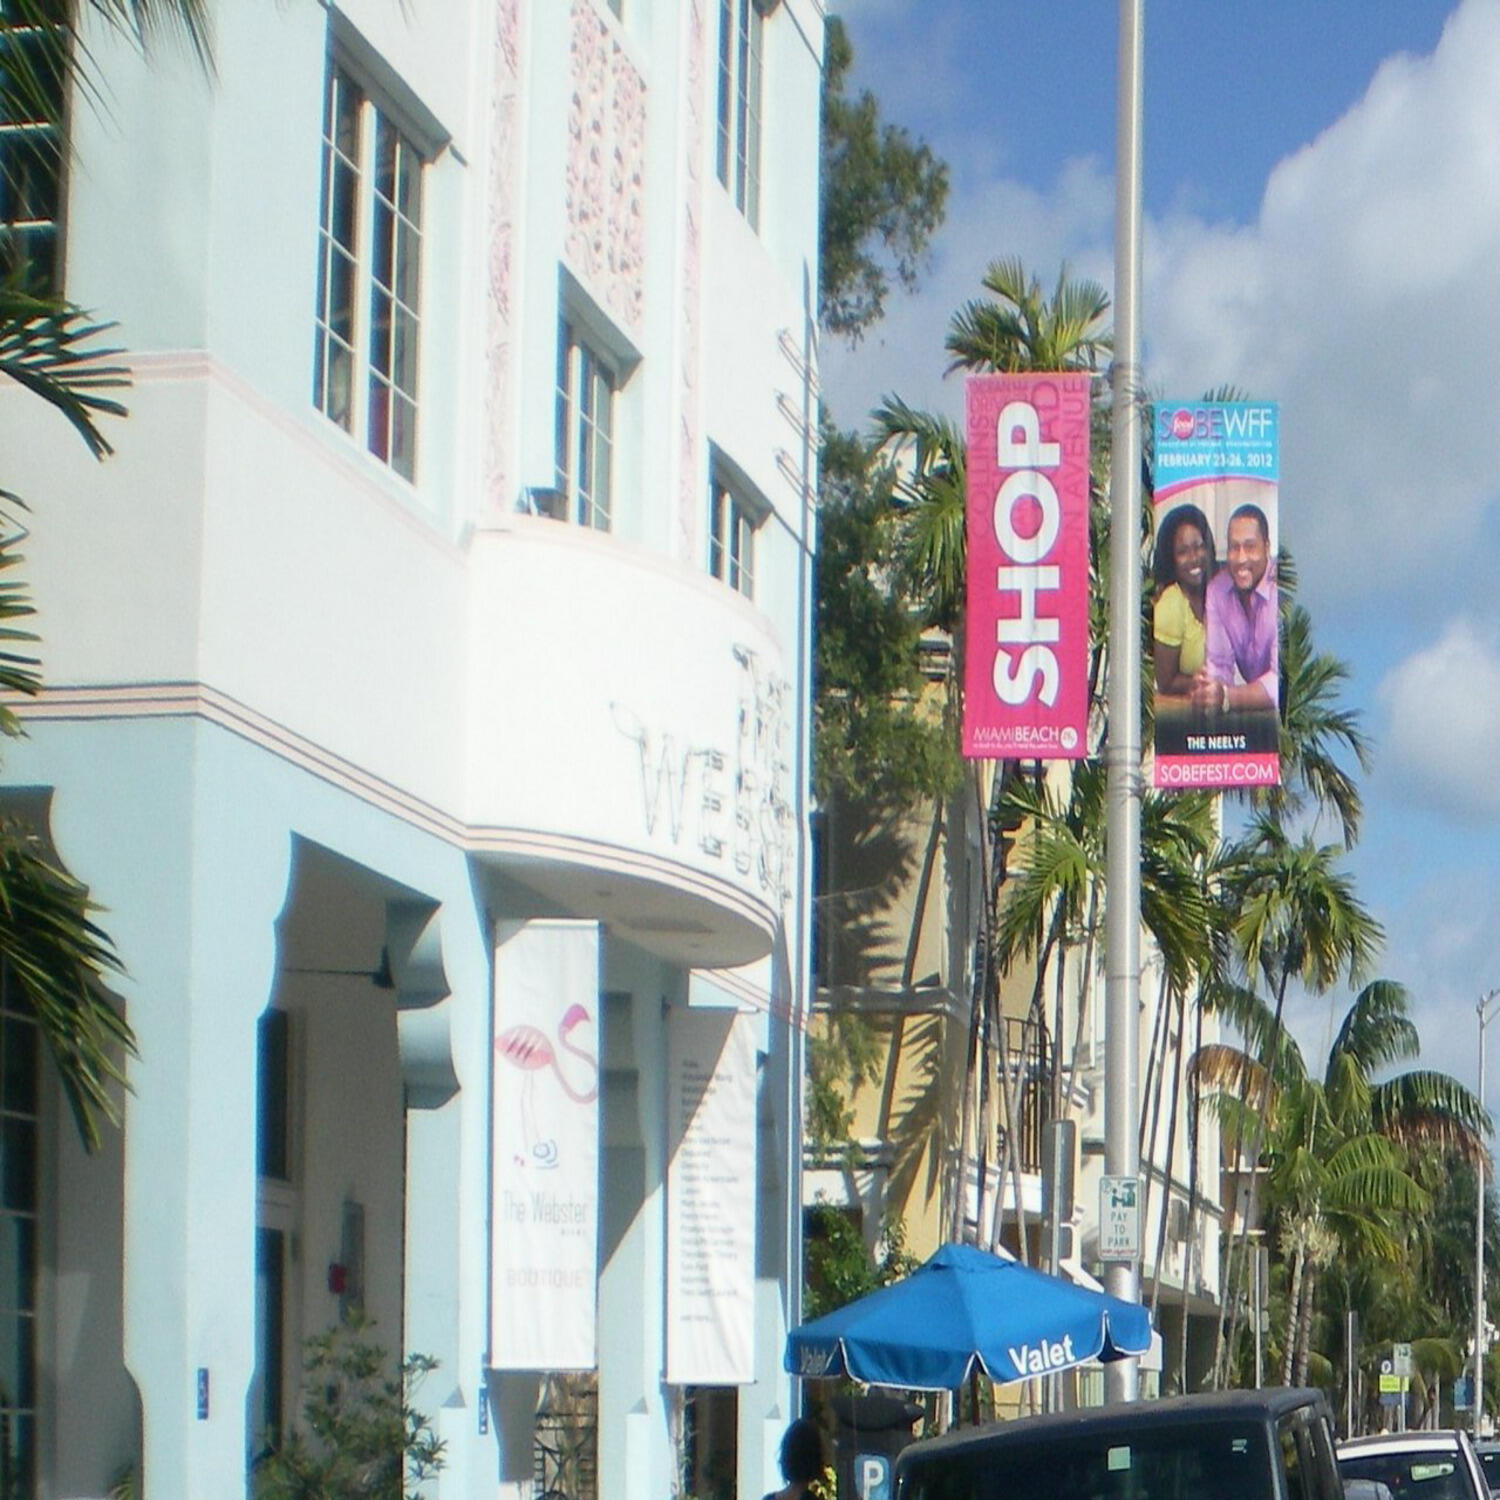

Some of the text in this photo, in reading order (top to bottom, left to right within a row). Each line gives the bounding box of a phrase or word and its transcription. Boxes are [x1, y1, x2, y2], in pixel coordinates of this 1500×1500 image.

[1158, 453, 1212, 468] FEBRUARY
[1247, 453, 1273, 468] 2012
[993, 401, 1060, 708] SHOP
[1187, 735, 1247, 750] THE NEELYS
[1161, 762, 1274, 782] SOBEFEST.COM
[504, 1191, 588, 1224] The Webster
[1111, 1211, 1127, 1222] PAY
[1114, 1224, 1125, 1234] TO
[1107, 1237, 1130, 1247] PARK
[507, 1267, 584, 1288] BOUTIQUE
[1008, 1333, 1076, 1375] Valet
